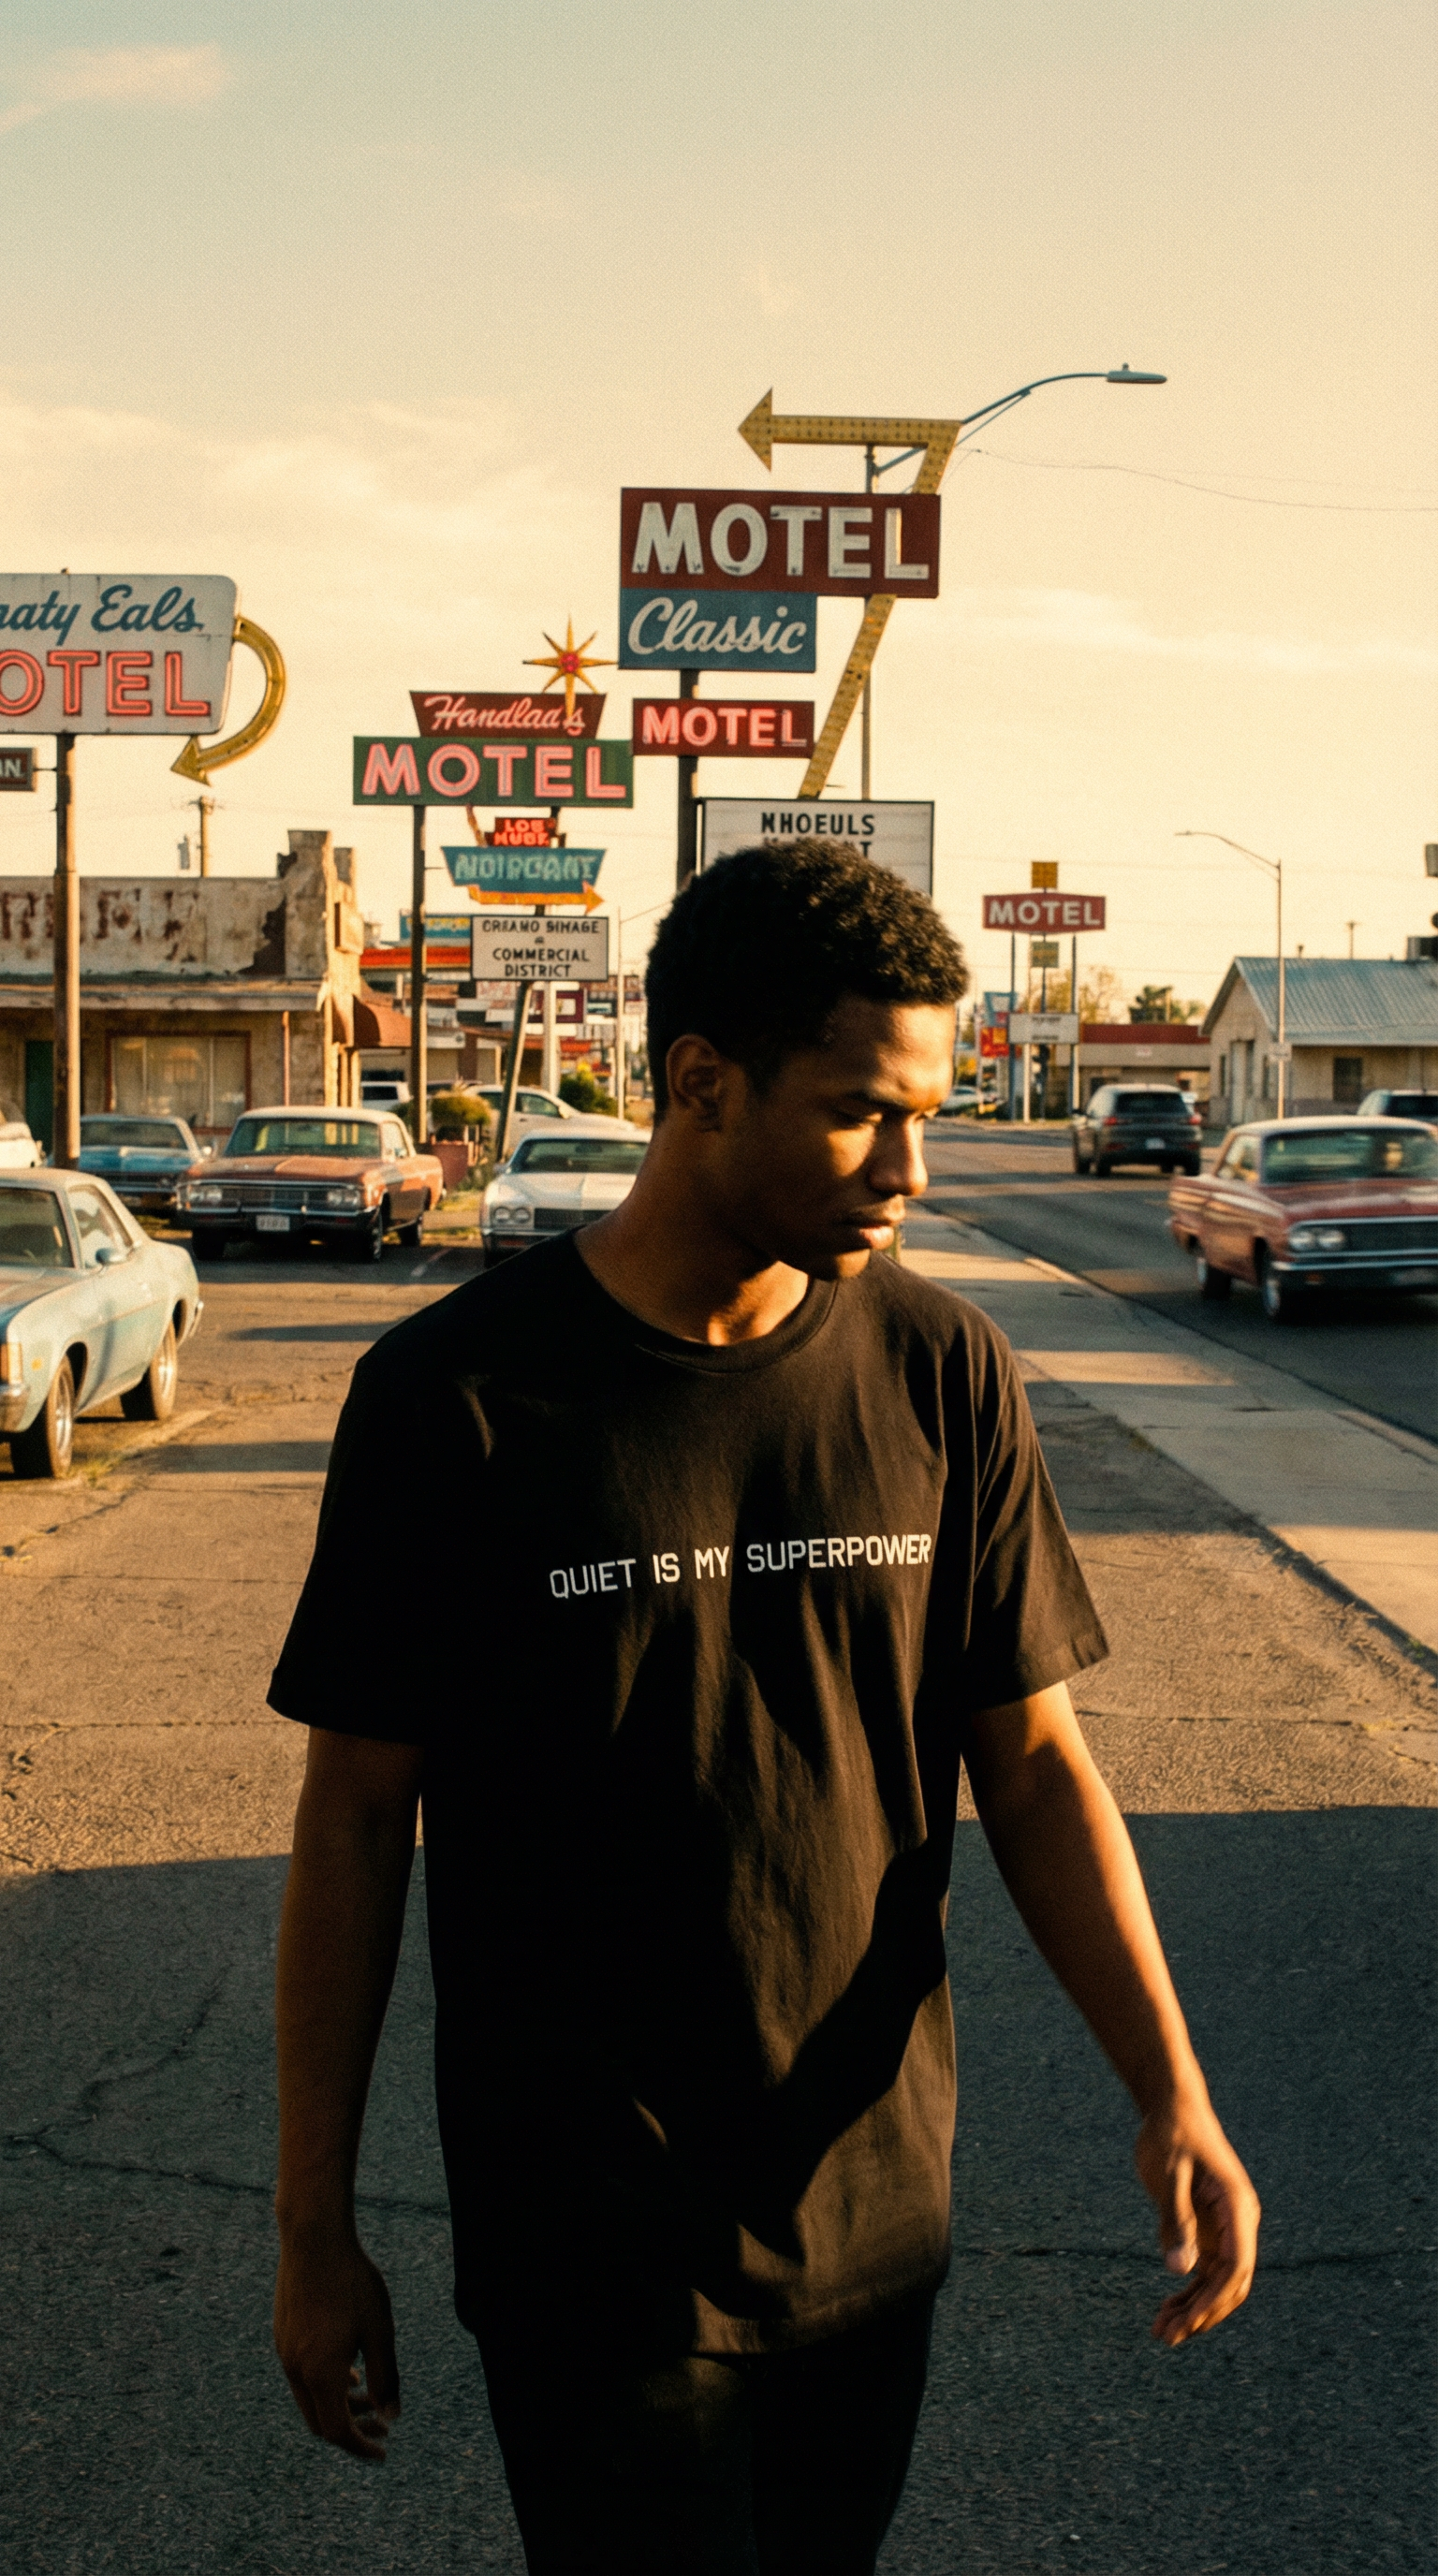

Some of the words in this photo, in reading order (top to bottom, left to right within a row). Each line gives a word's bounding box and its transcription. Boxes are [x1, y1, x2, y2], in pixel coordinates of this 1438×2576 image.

[632, 502, 929, 579] MOTEL
[628, 597, 807, 654] Classic
[642, 706, 807, 747] MOTEL
[362, 743, 626, 798] MOTEL
[988, 900, 1101, 926] MOTEL
[492, 948, 591, 962] COMMERCIAL
[505, 964, 571, 977] DISTRICT
[550, 1559, 637, 1600] QUIET
[653, 1553, 681, 1585] IS
[695, 1546, 730, 1580] MY
[746, 1534, 932, 1573] SUPERPOWER
